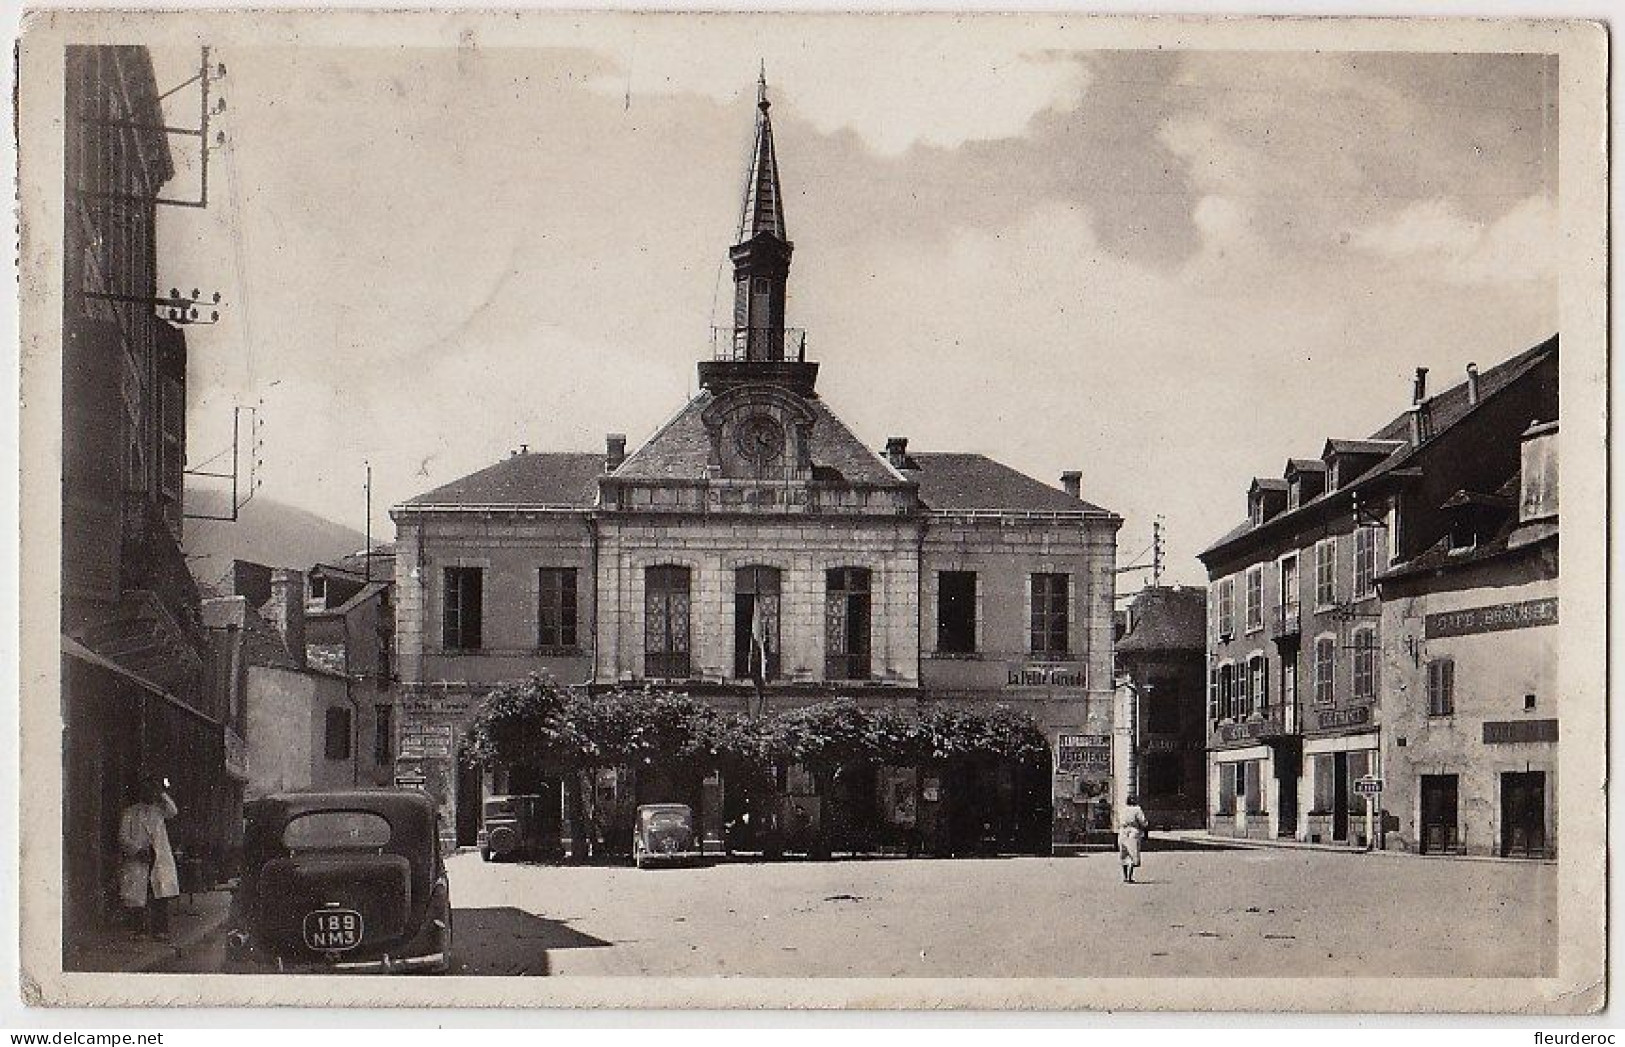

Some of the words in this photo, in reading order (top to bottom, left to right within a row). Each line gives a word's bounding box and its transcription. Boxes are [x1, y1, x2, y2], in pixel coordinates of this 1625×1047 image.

[1008, 670, 1019, 685] La
[318, 915, 355, 931] 189
[314, 931, 355, 947] NM3
